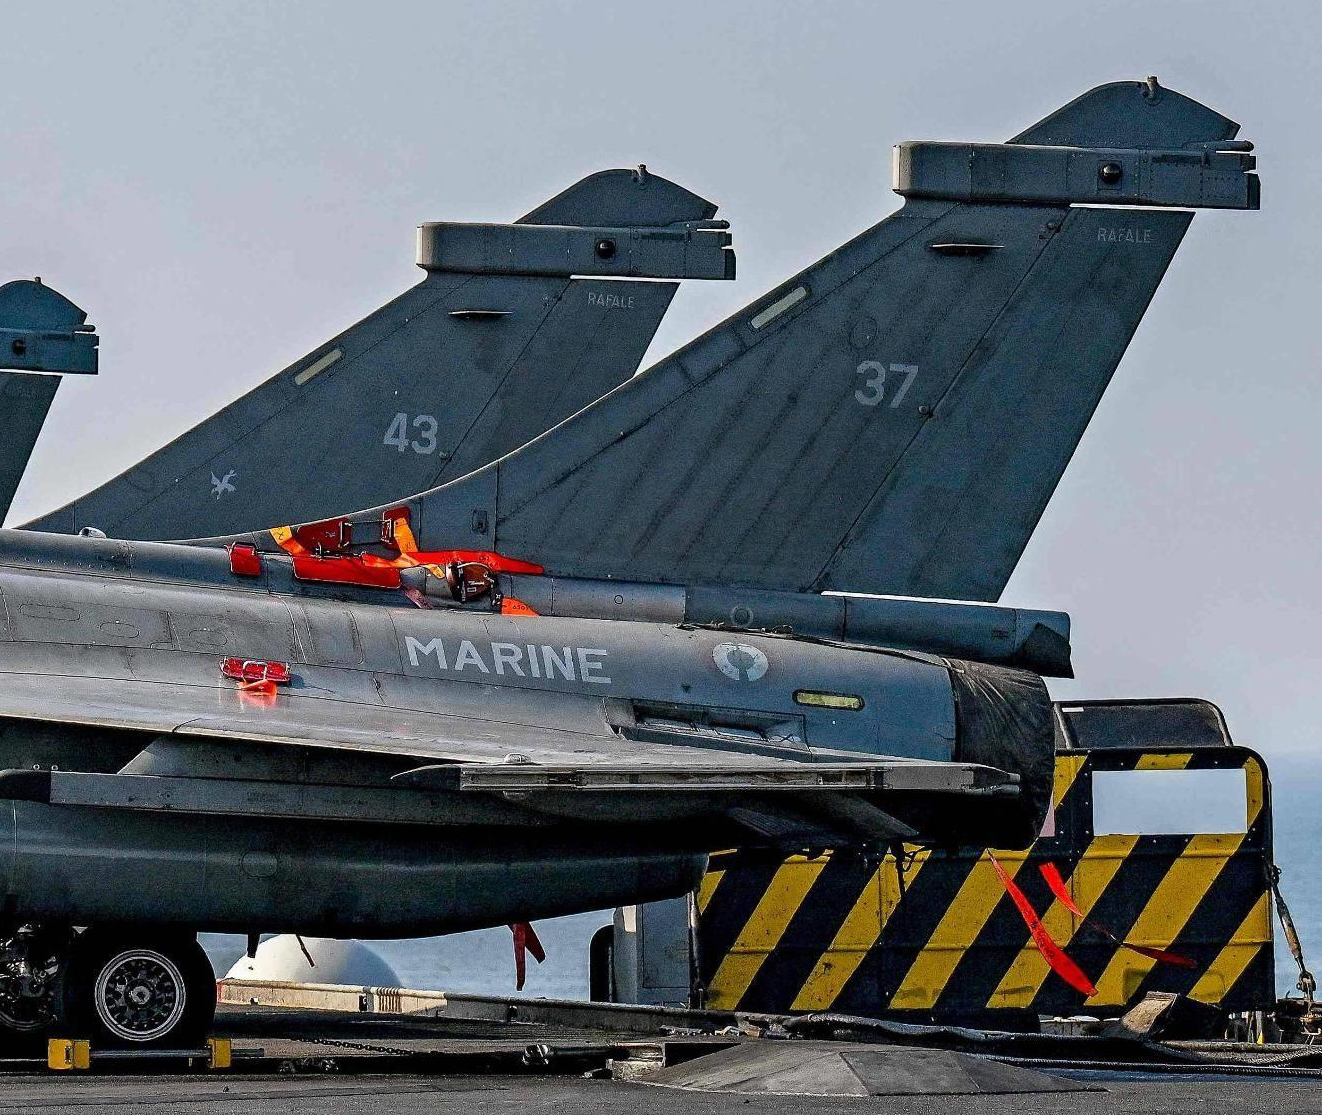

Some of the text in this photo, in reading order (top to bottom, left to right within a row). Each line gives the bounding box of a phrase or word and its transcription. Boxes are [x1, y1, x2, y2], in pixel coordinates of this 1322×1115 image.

[1097, 227, 1151, 243] RAFALE
[587, 292, 635, 308] RAFALE
[854, 360, 919, 409] 37
[383, 412, 439, 455] 43
[404, 635, 612, 684] MARINE
